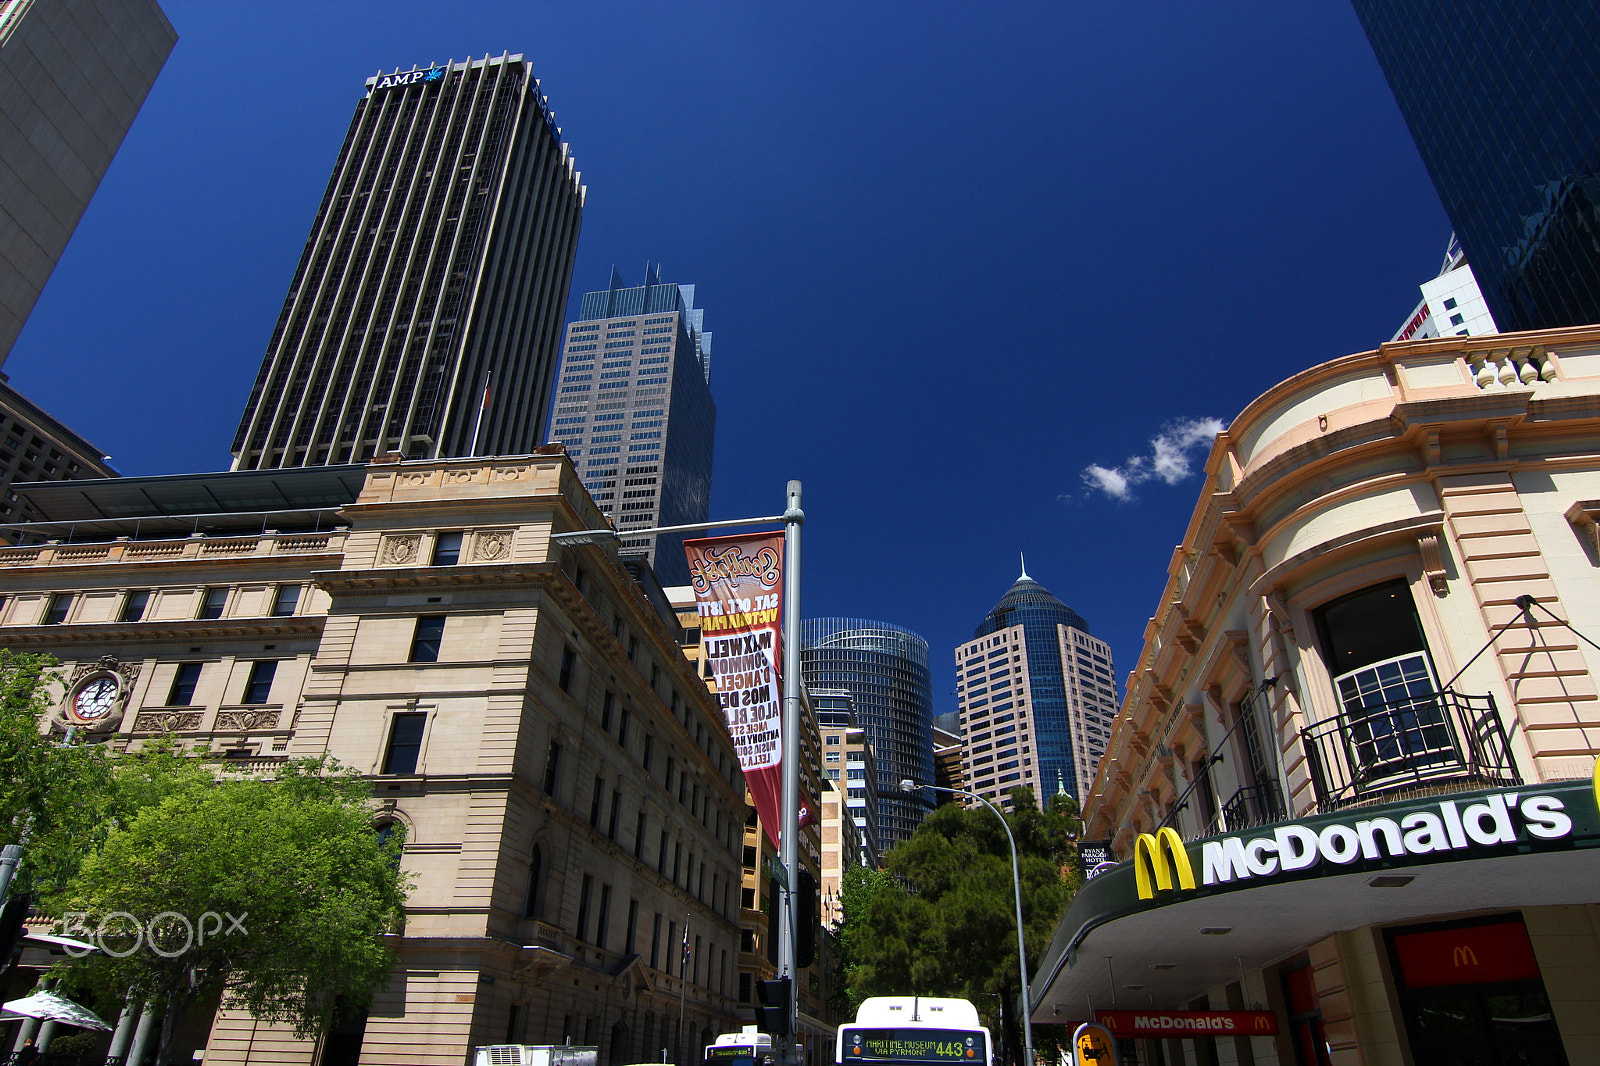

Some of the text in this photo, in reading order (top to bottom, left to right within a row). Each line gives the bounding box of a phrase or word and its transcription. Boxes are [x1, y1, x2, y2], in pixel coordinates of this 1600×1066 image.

[377, 71, 424, 89] AMP
[1202, 791, 1573, 885] McDonald's
[1134, 1015, 1235, 1030] McDonald's
[866, 1040, 937, 1050] MARITIME MUSEUM
[875, 1048, 927, 1057] VIA PYRMONT
[935, 1041, 963, 1057] 443
